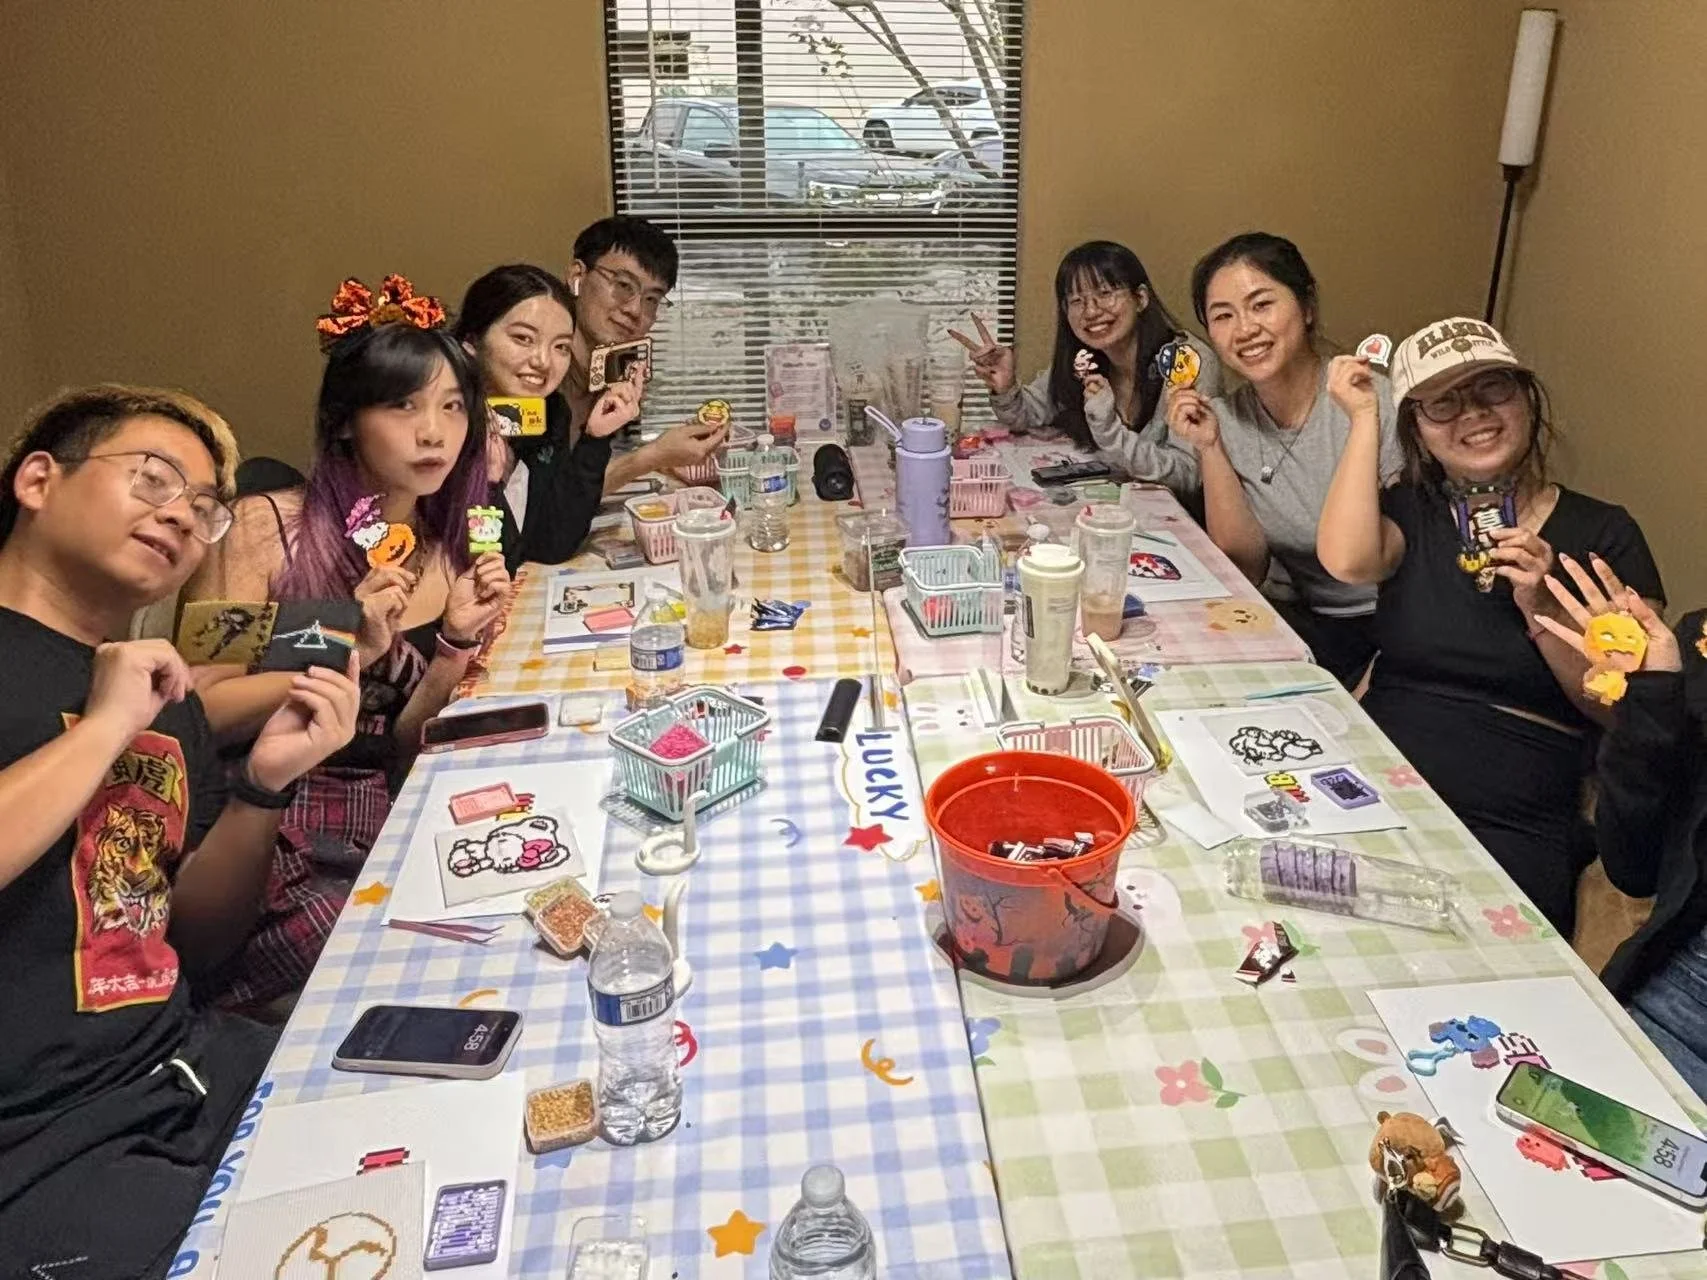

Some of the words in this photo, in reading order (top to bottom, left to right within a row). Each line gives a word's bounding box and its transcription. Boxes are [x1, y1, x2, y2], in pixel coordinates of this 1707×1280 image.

[855, 733, 909, 821] LUCKY
[463, 1023, 489, 1051] 4:58
[1652, 1137, 1680, 1169] 4:58
